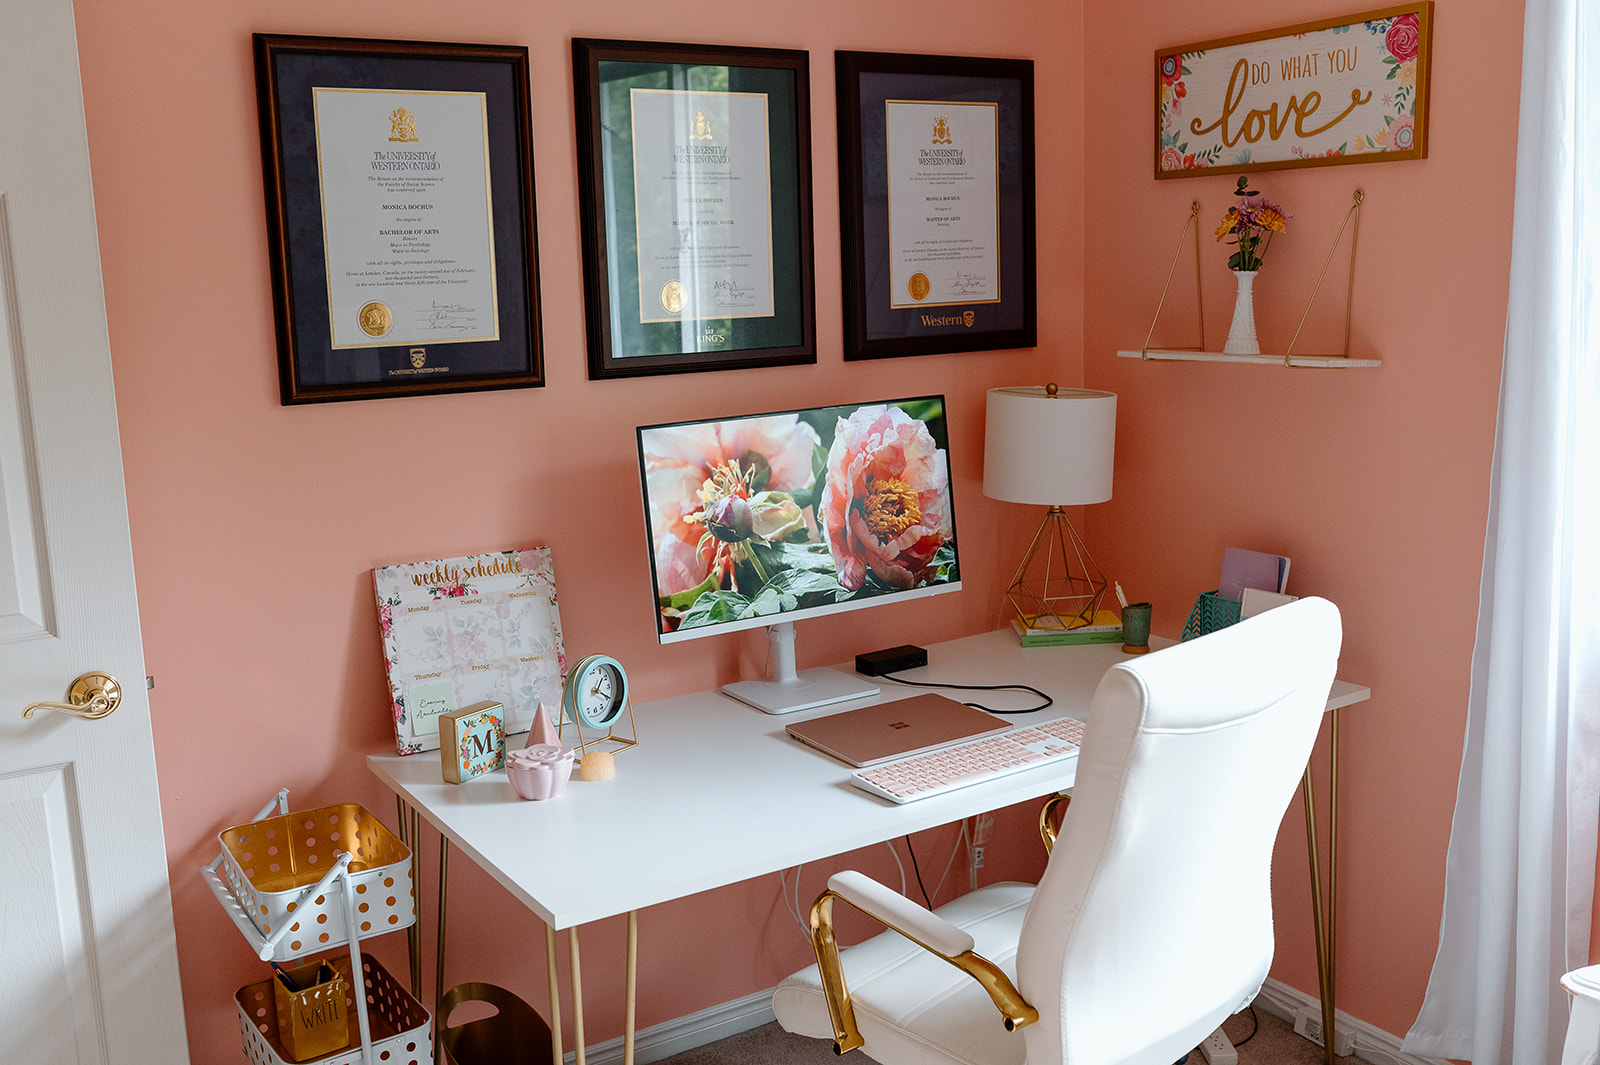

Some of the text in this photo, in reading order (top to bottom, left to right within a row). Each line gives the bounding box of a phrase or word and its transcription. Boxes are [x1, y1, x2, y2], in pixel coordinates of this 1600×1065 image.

[1252, 46, 1358, 86] DO WHAT YOU
[1190, 58, 1372, 148] love
[371, 162, 440, 170] WESTERN ONTARIO
[374, 152, 386, 160] The
[386, 152, 430, 160] UNIVERSITY
[921, 315, 962, 326] Western
[697, 334, 725, 343] KING'S
[411, 556, 524, 590] weekly schedule
[408, 590, 537, 613] Monday Tuesday Wednesday
[414, 672, 442, 680] Thursday
[520, 655, 544, 663] Weekend
[471, 729, 494, 759] M
